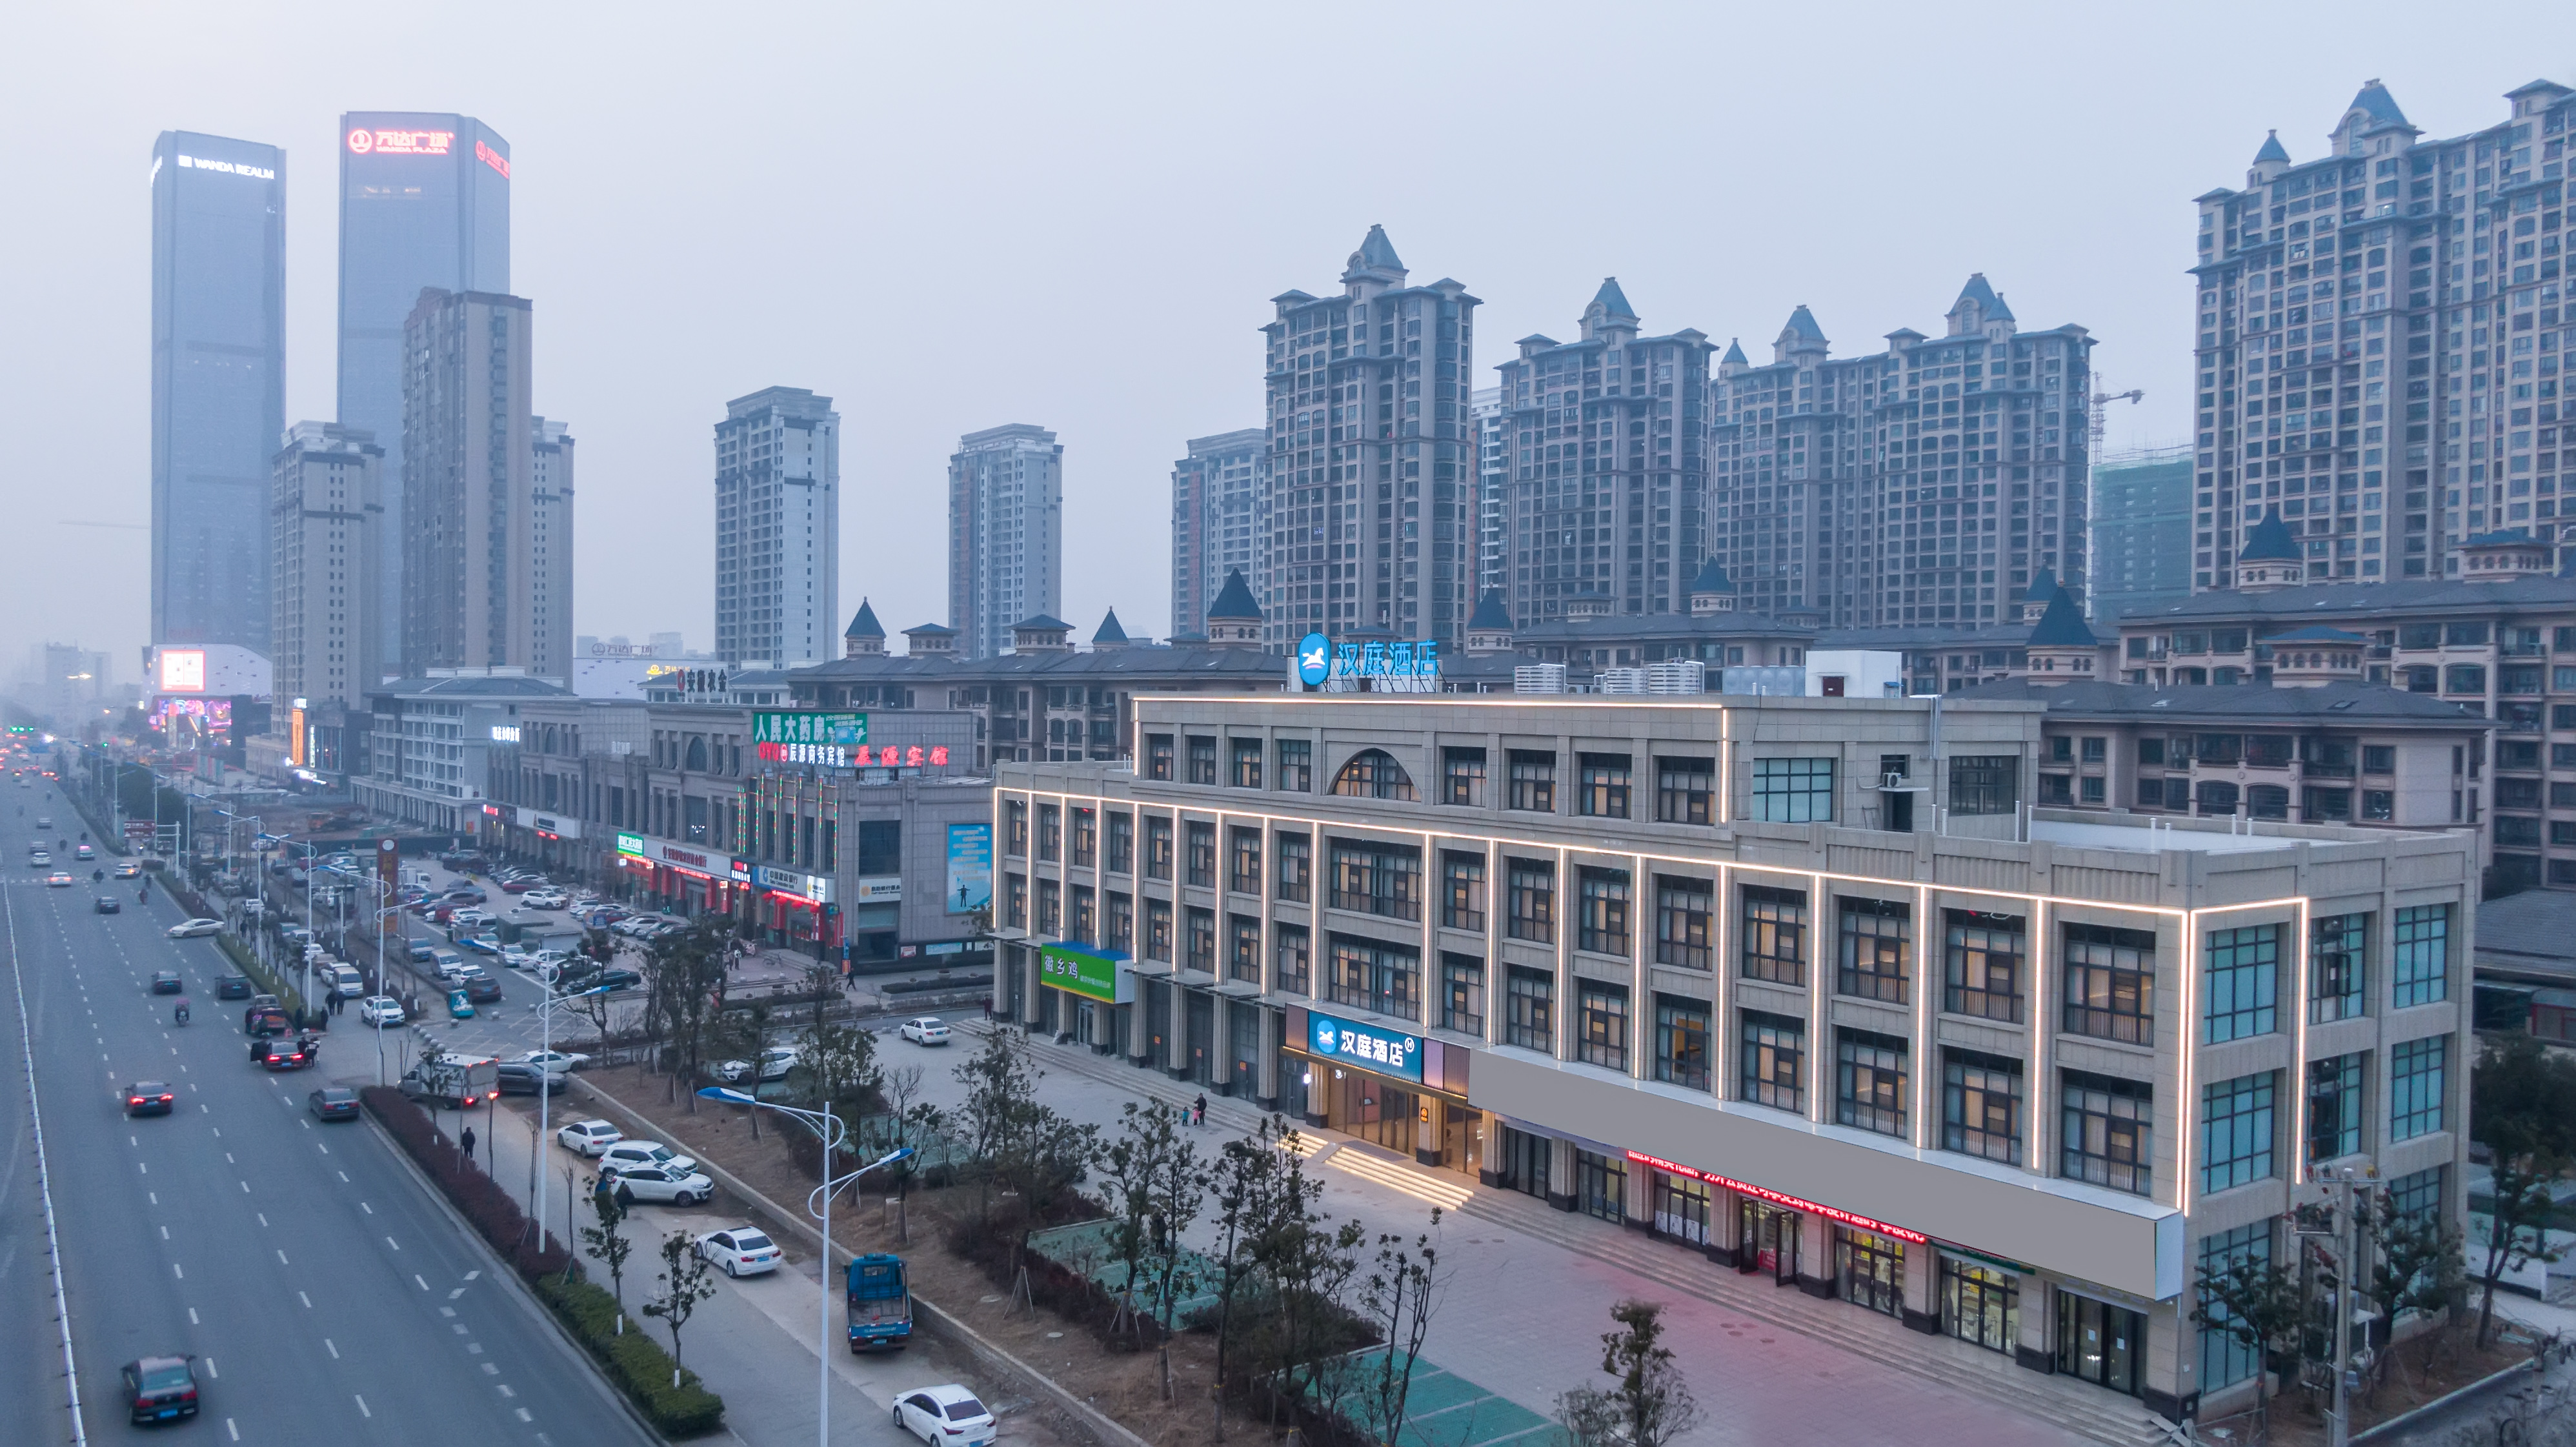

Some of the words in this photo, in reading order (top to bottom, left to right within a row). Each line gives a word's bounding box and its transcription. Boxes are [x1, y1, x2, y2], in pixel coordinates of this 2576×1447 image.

[376, 131, 449, 147] 万达广场
[194, 157, 235, 174] WANDA
[235, 163, 275, 180] REALM
[607, 645, 652, 654] 万达广场
[1338, 639, 1438, 676] 汉庭酒店
[687, 669, 727, 693] 安徽农金
[756, 714, 825, 742] 人民大药房
[758, 740, 780, 761] OYO
[789, 743, 845, 767] 辰源商务宾馆
[854, 745, 949, 767] 辰源宾馆
[770, 870, 798, 885] 中国建设银行
[1045, 954, 1078, 980] 徽乡鸡
[1341, 1029, 1404, 1068] 汉庭酒店
